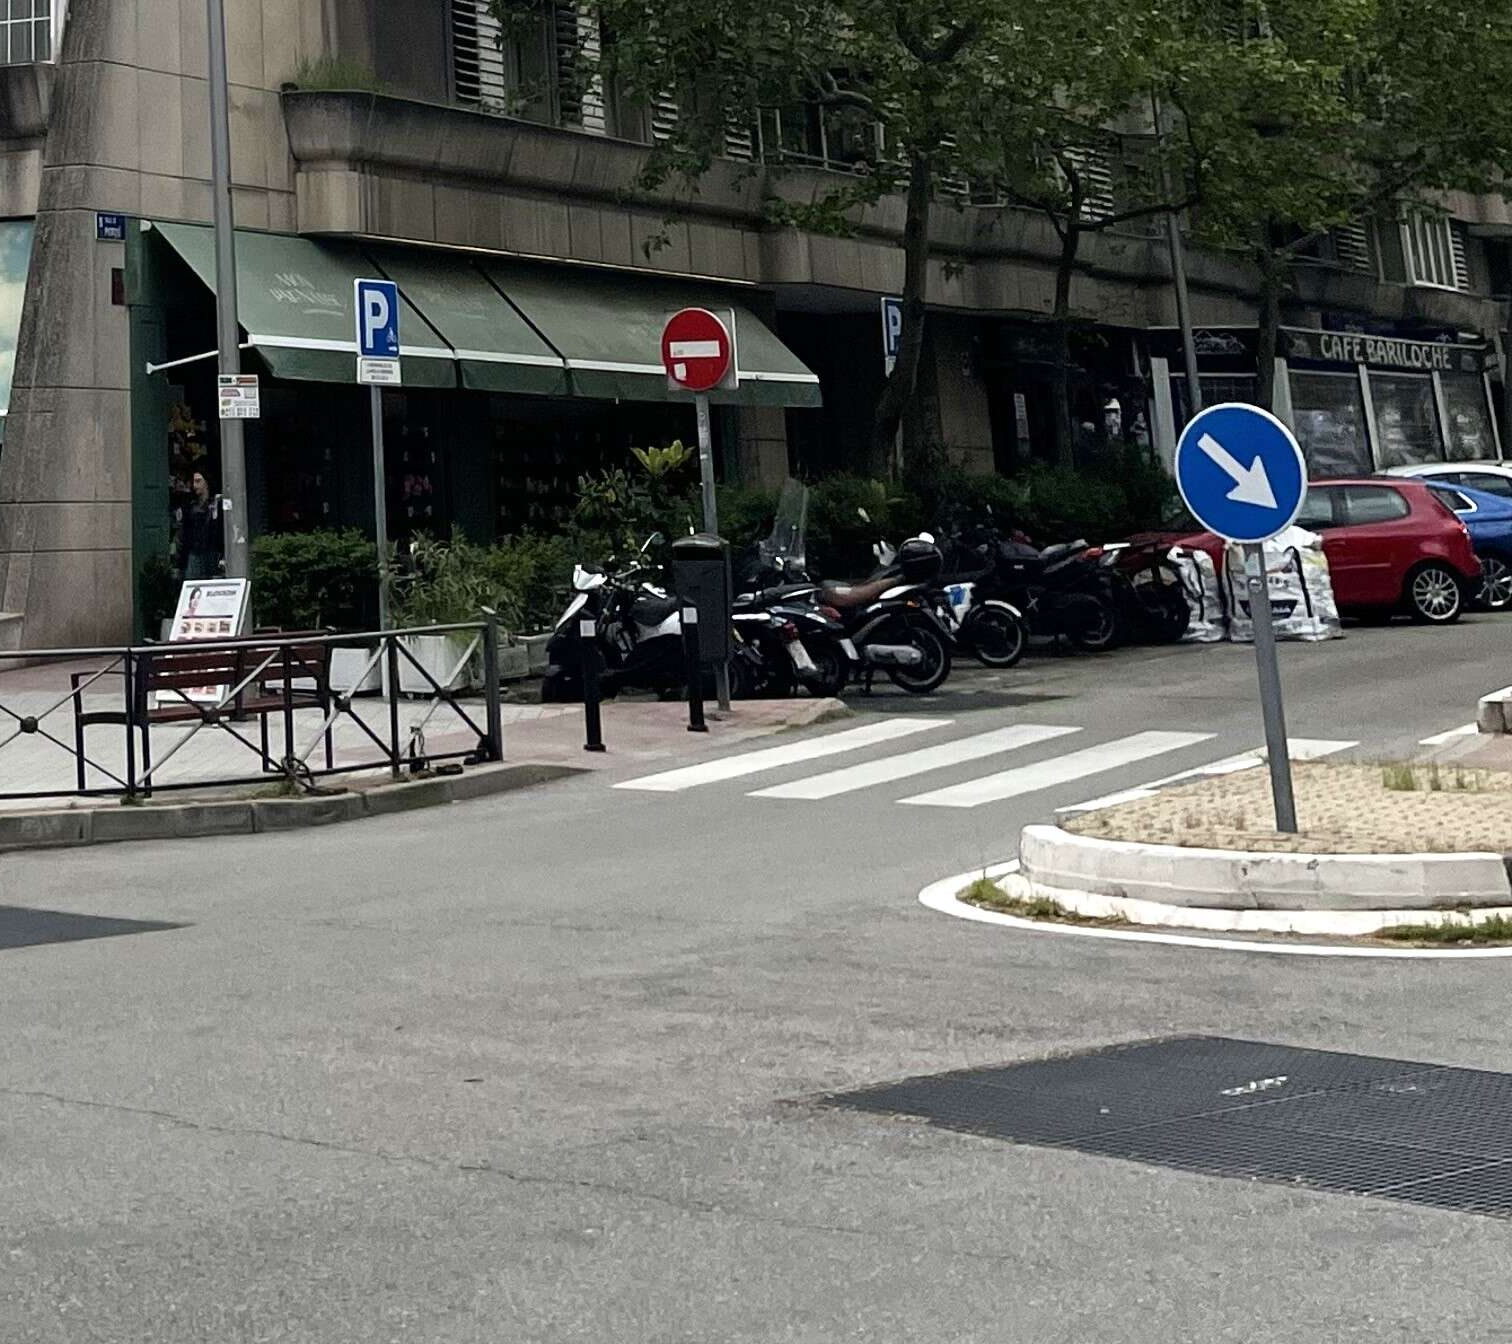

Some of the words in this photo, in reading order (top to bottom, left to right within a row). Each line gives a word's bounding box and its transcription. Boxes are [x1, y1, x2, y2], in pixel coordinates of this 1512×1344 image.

[364, 289, 389, 349] P
[887, 305, 903, 352] P
[1365, 339, 1453, 369] BARILOCHE
